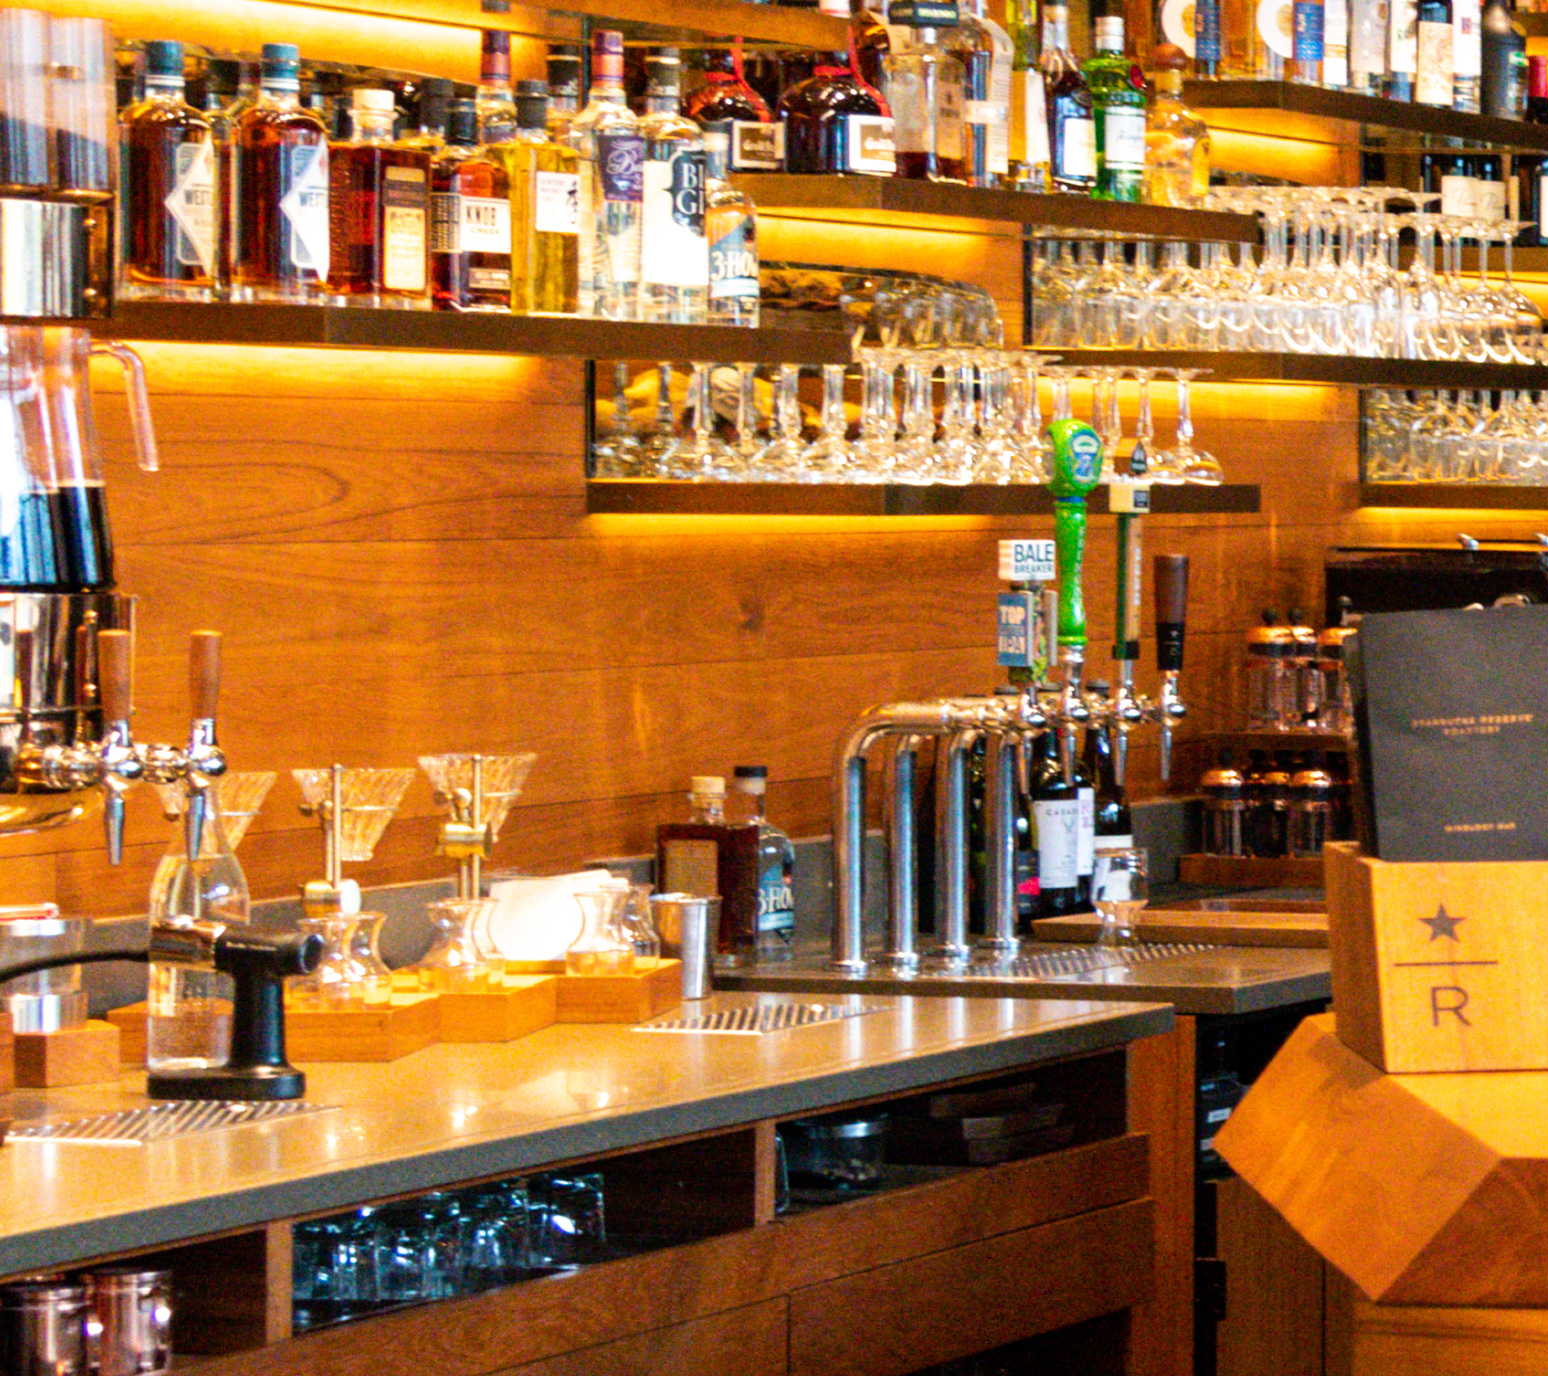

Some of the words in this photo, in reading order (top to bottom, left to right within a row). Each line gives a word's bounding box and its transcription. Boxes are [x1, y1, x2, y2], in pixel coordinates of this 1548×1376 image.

[1014, 544, 1054, 563] BALE
[1014, 564, 1054, 574] BREAKER
[1000, 606, 1025, 625] TOP
[1429, 985, 1474, 1027] R
